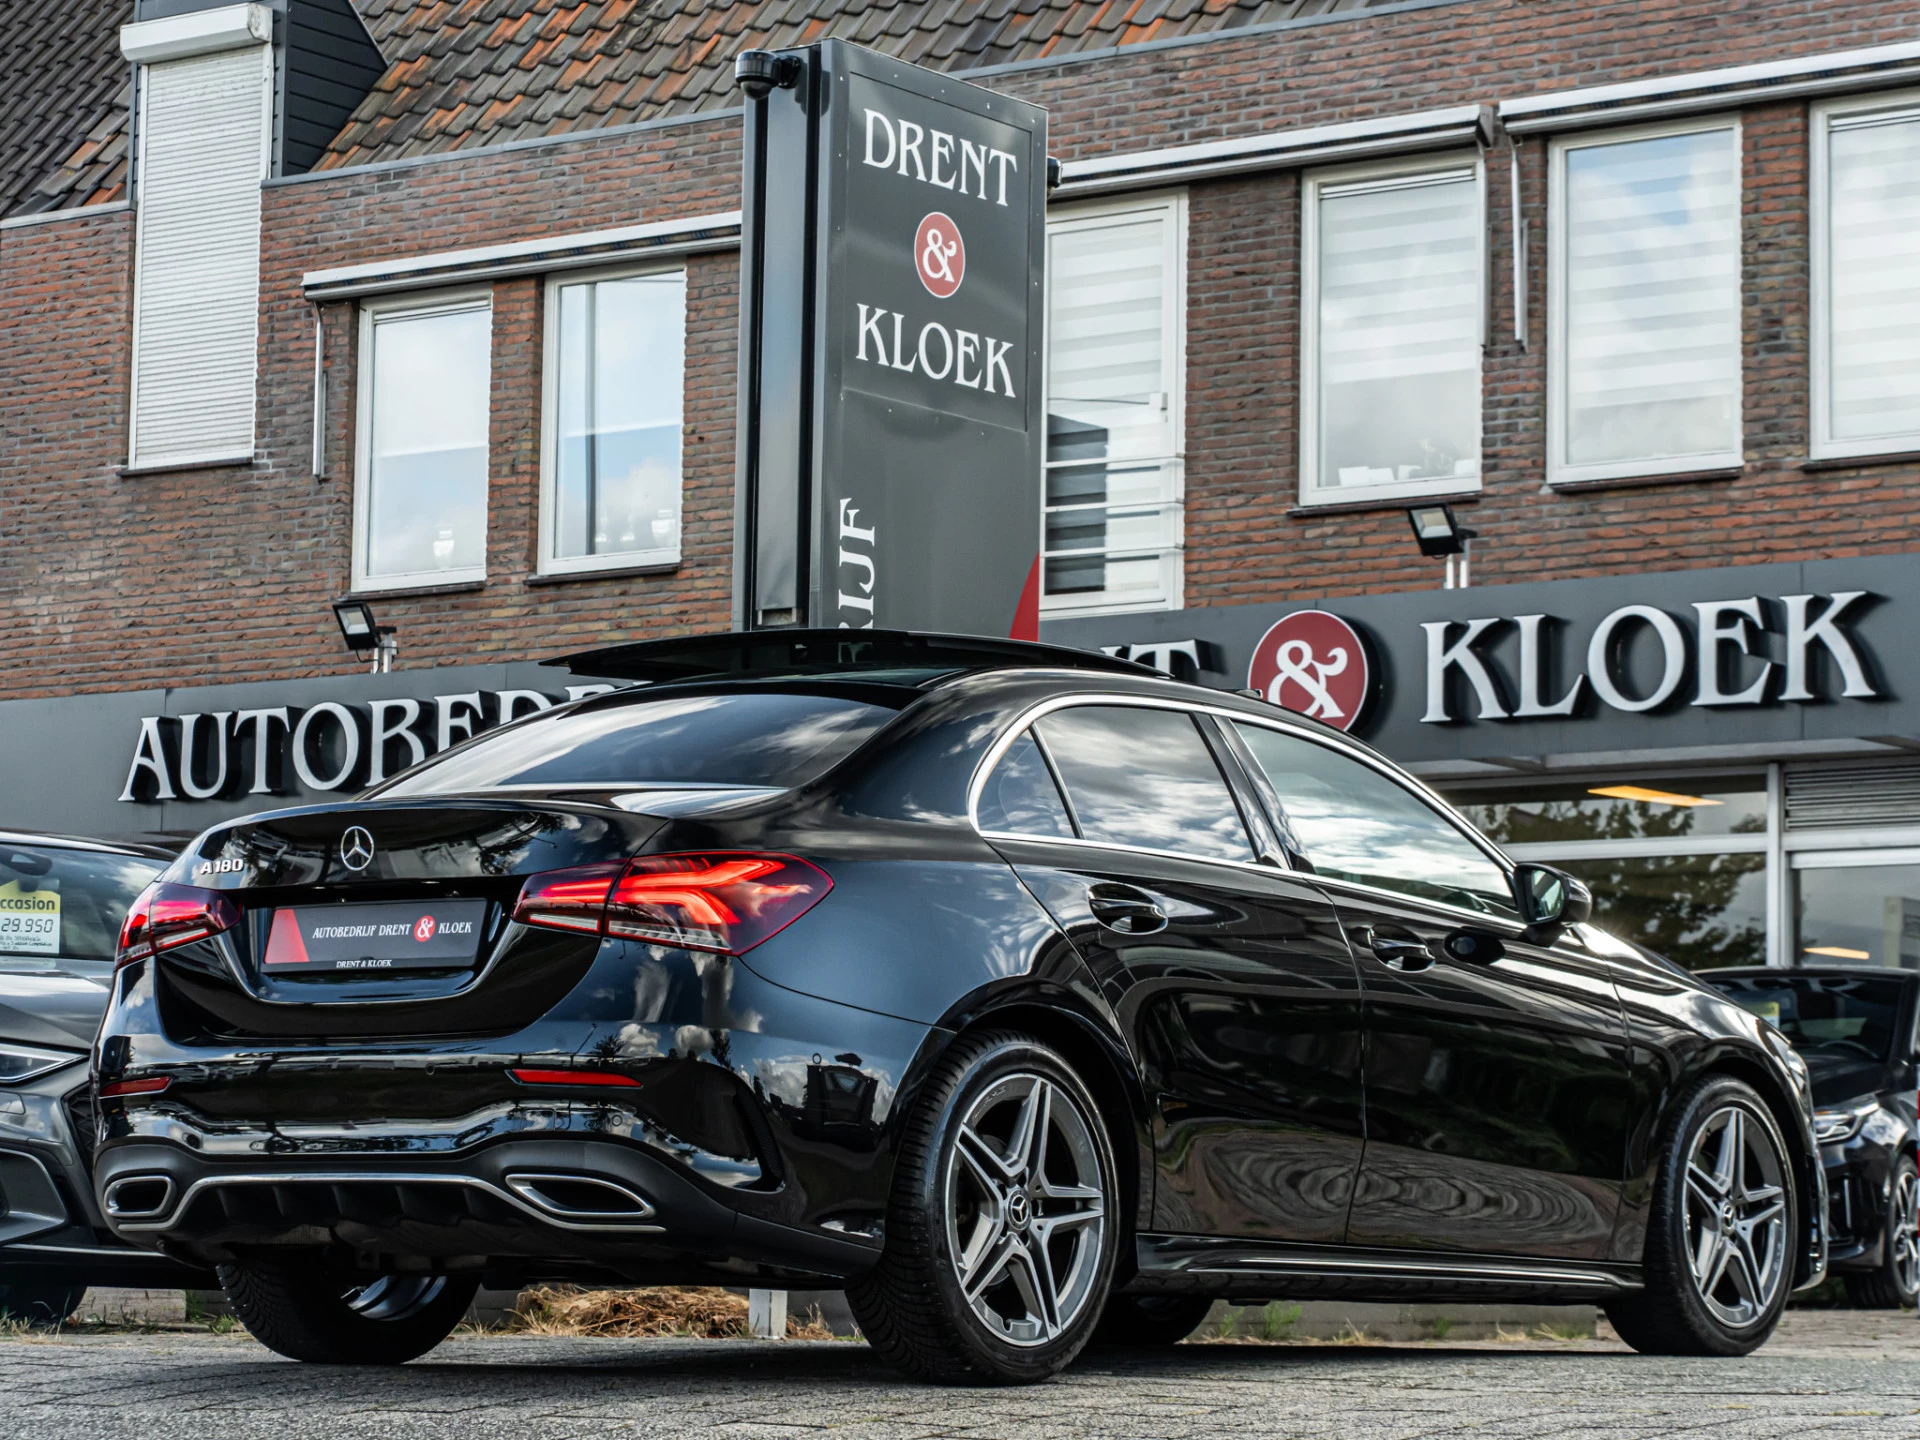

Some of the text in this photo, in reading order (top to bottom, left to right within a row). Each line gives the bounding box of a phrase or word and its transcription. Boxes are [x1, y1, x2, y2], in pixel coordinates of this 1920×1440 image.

[862, 107, 1018, 207] DRENT
[922, 228, 957, 283] &
[855, 302, 1017, 398] KLOEK
[837, 497, 876, 630] IJF
[1267, 639, 1348, 718] &
[1419, 591, 1876, 722] KLOEK
[312, 917, 472, 939] AUTOBEDRIJF DRENT & KLOEK
[336, 959, 361, 968] DRENT
[368, 958, 393, 968] KLOEK
